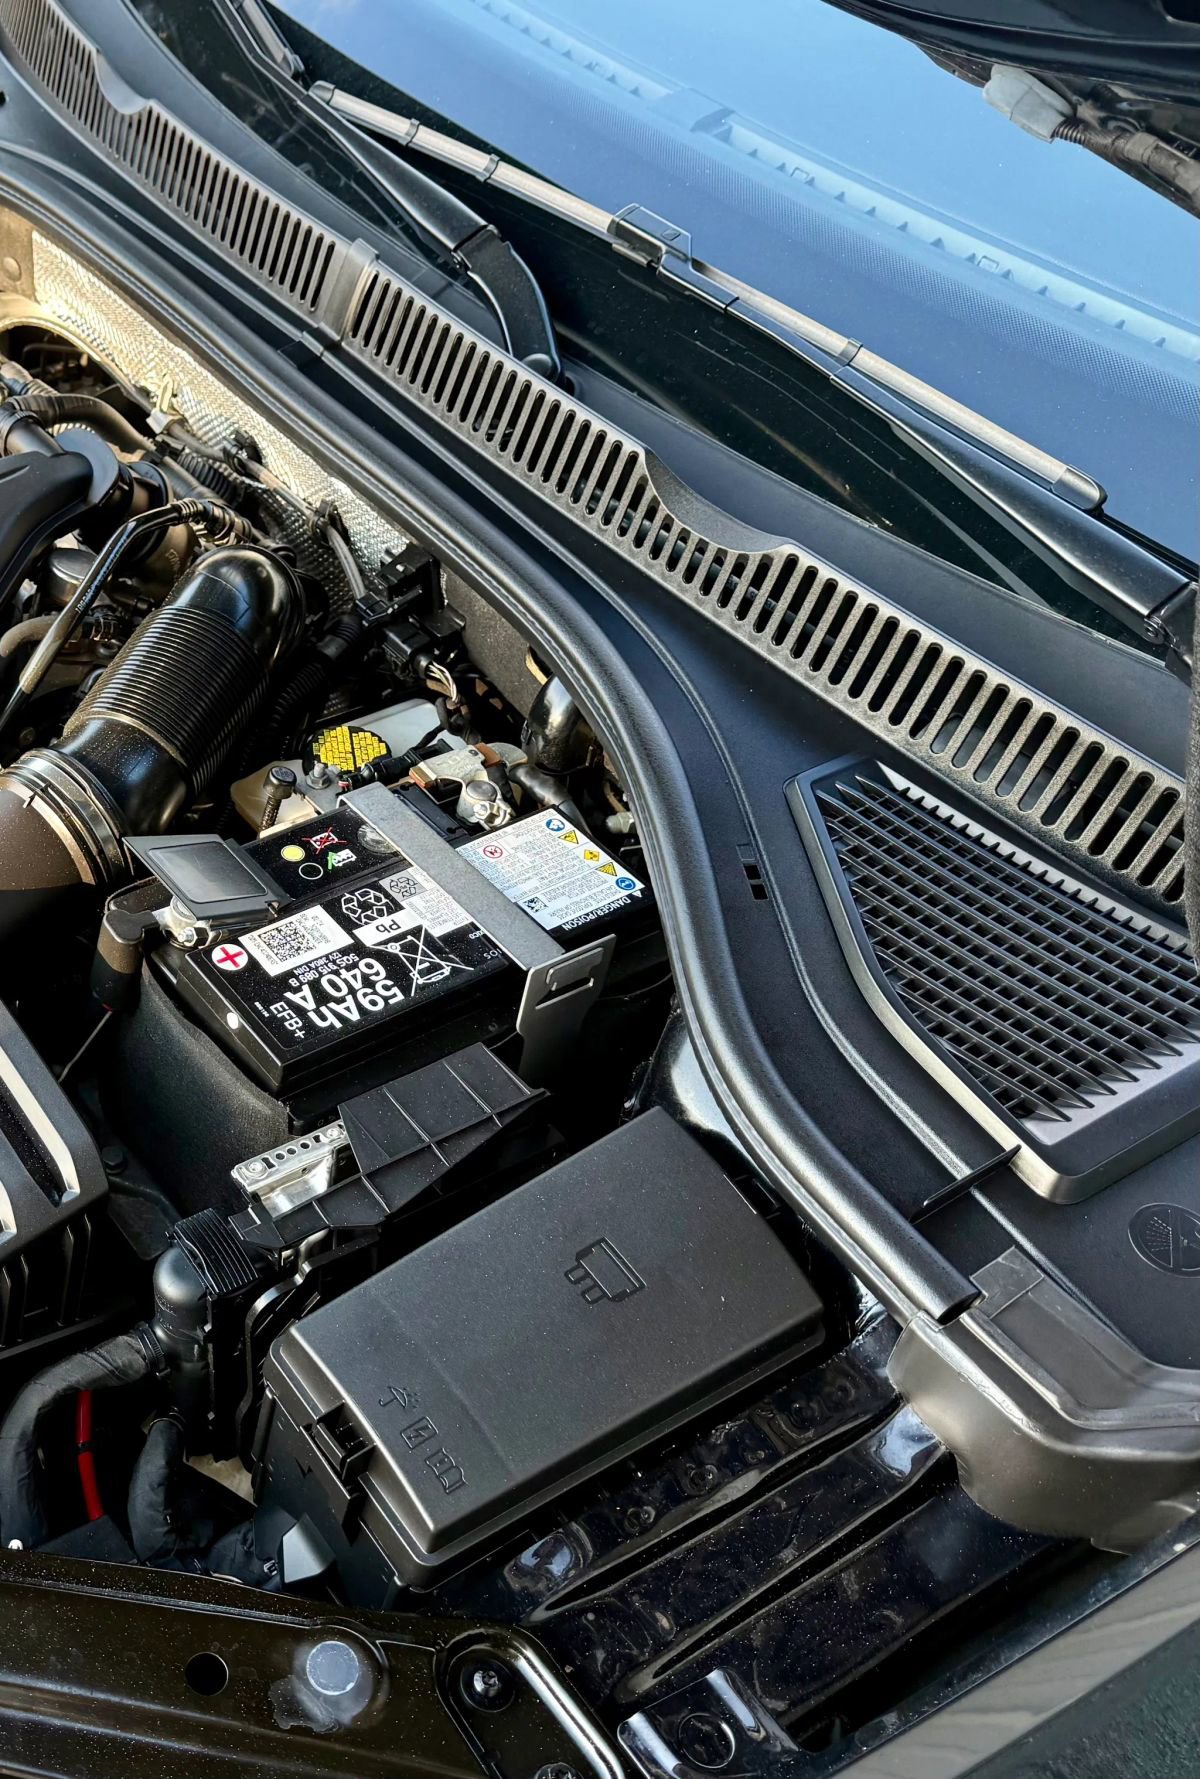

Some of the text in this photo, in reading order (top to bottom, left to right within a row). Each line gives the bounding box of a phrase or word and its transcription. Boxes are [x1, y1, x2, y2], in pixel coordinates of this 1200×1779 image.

[375, 918, 400, 932] Pb
[561, 896, 631, 930] DANGER/POISON
[288, 953, 358, 987] 5QS 915 089 B
[294, 951, 341, 975] 12V 380A DIN
[482, 948, 501, 959] IOS
[321, 958, 386, 997] 640
[283, 984, 316, 1011] A
[308, 979, 404, 1028] 59Ah
[269, 1001, 305, 1039] EFB+
